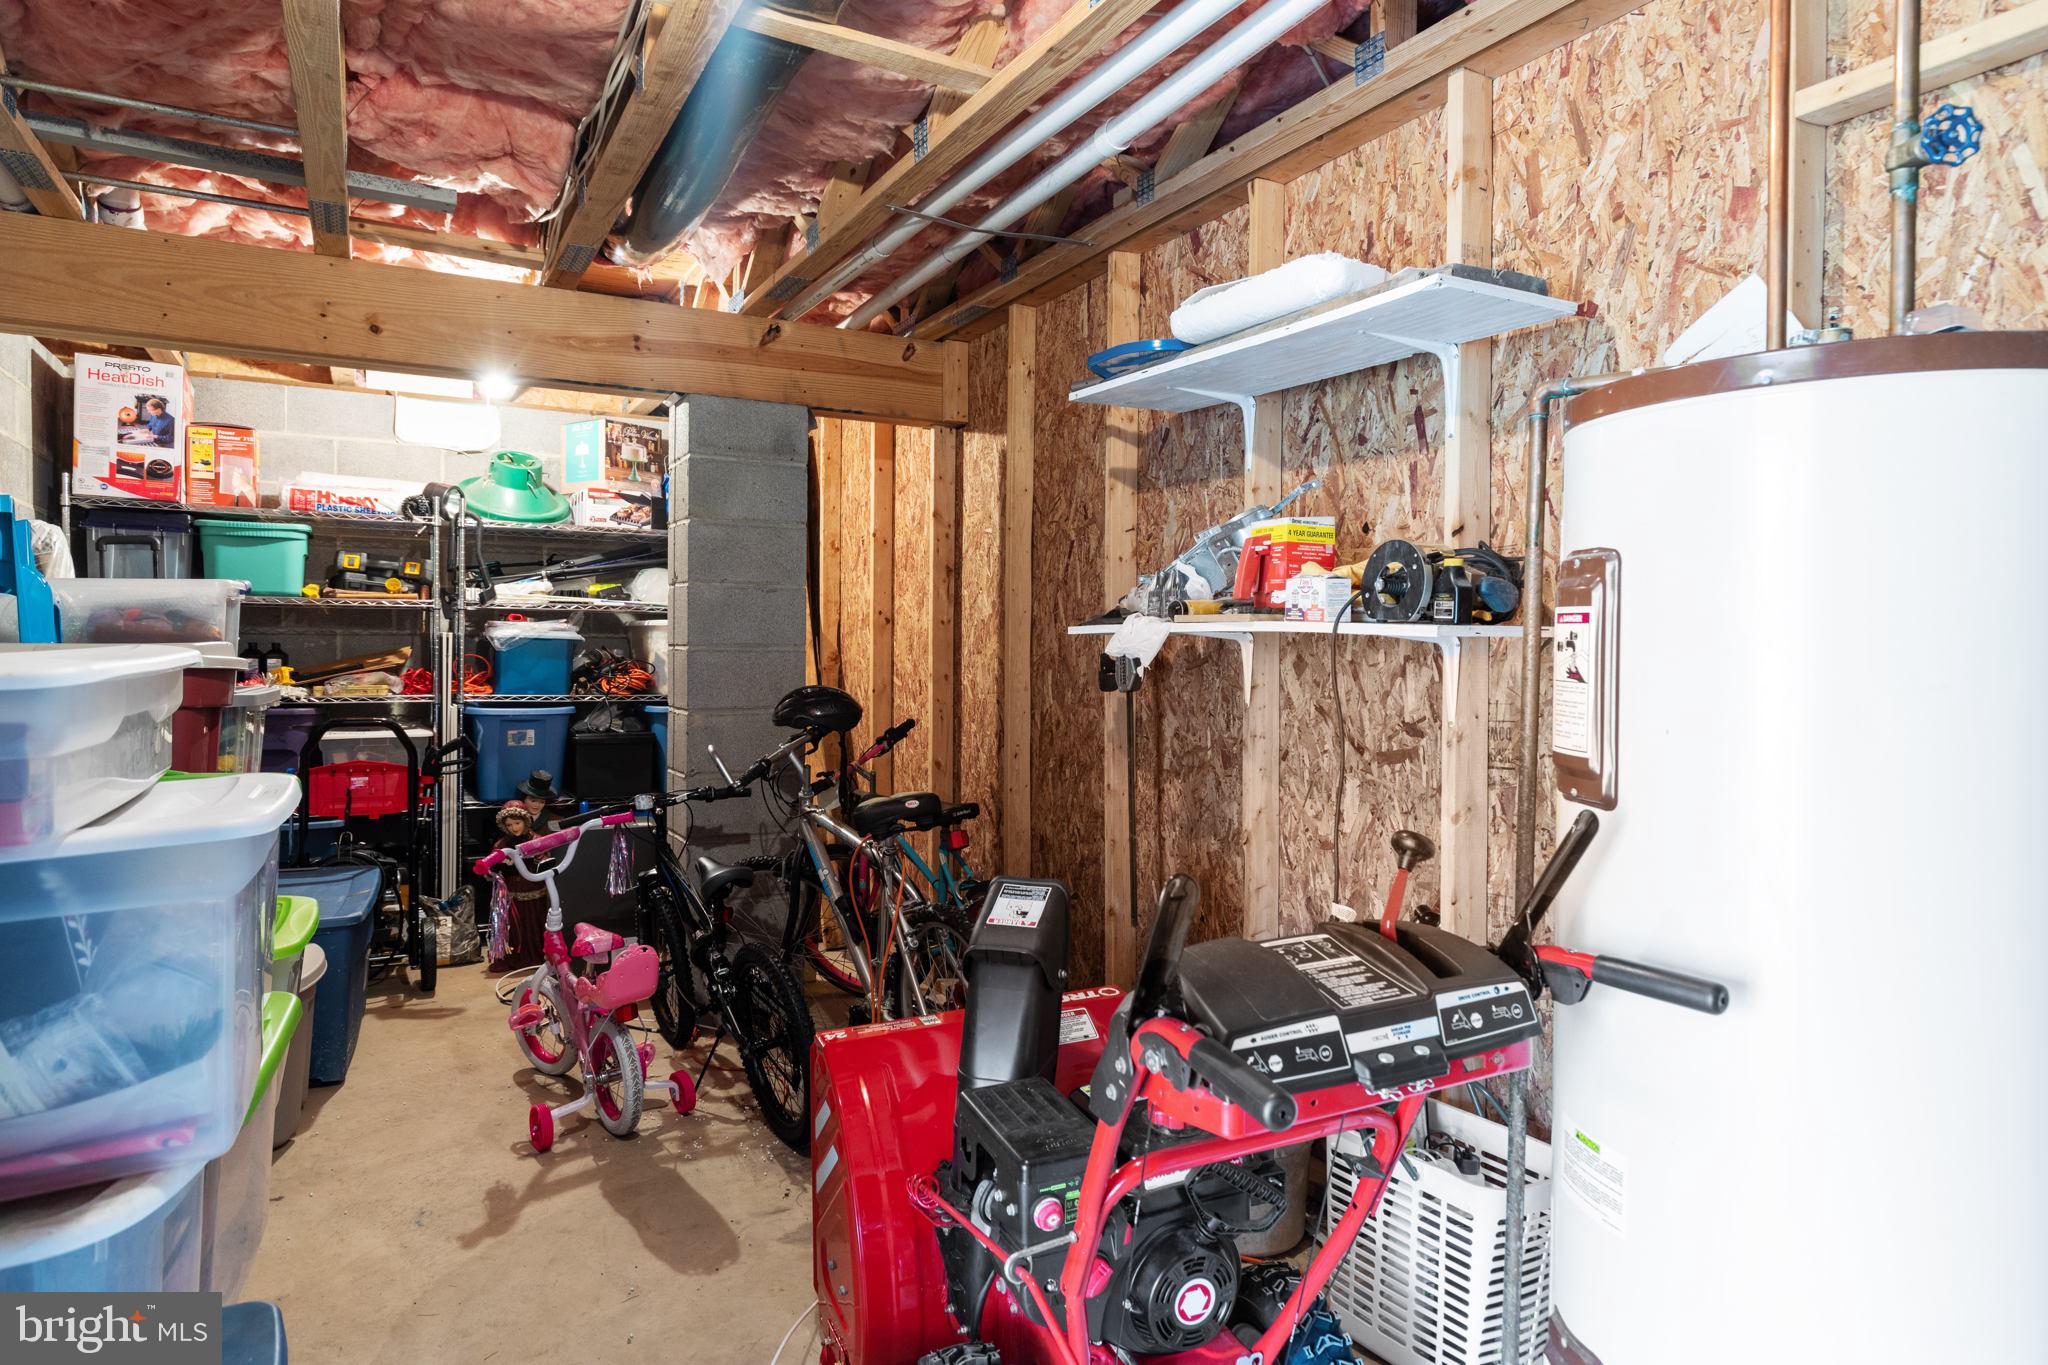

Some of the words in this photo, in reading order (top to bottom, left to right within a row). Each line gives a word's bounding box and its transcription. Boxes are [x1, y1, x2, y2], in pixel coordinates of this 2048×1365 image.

[104, 361, 151, 373] PRESTO
[317, 503, 352, 512] PLASTIC
[354, 506, 397, 515] SHEE
[1307, 531, 1334, 539] GUARANTEE
[1279, 1030, 1303, 1038] CONTROL
